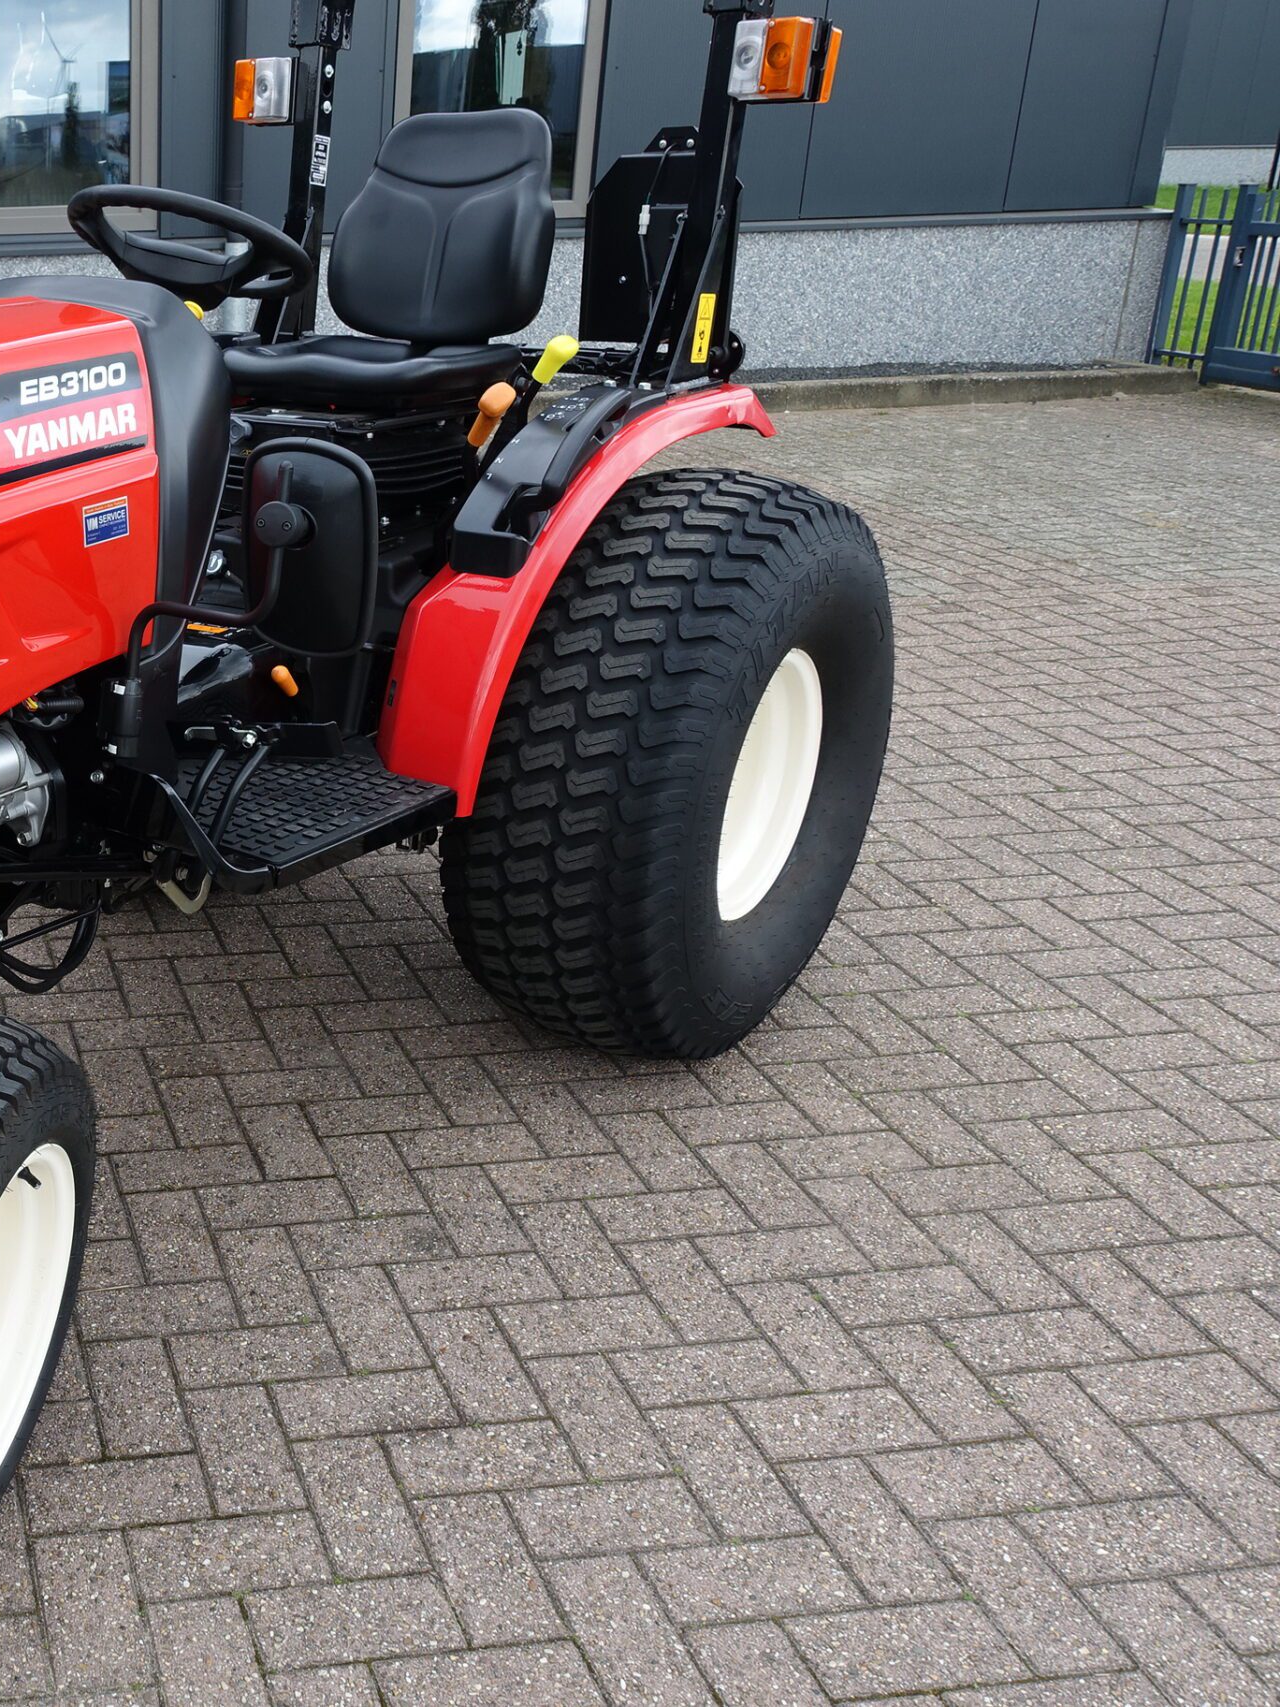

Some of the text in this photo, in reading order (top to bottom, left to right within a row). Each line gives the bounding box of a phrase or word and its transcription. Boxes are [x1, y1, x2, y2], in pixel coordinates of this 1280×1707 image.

[20, 362, 126, 405] EB3100
[4, 403, 137, 459] YANMAR
[98, 509, 126, 525] SERVICE
